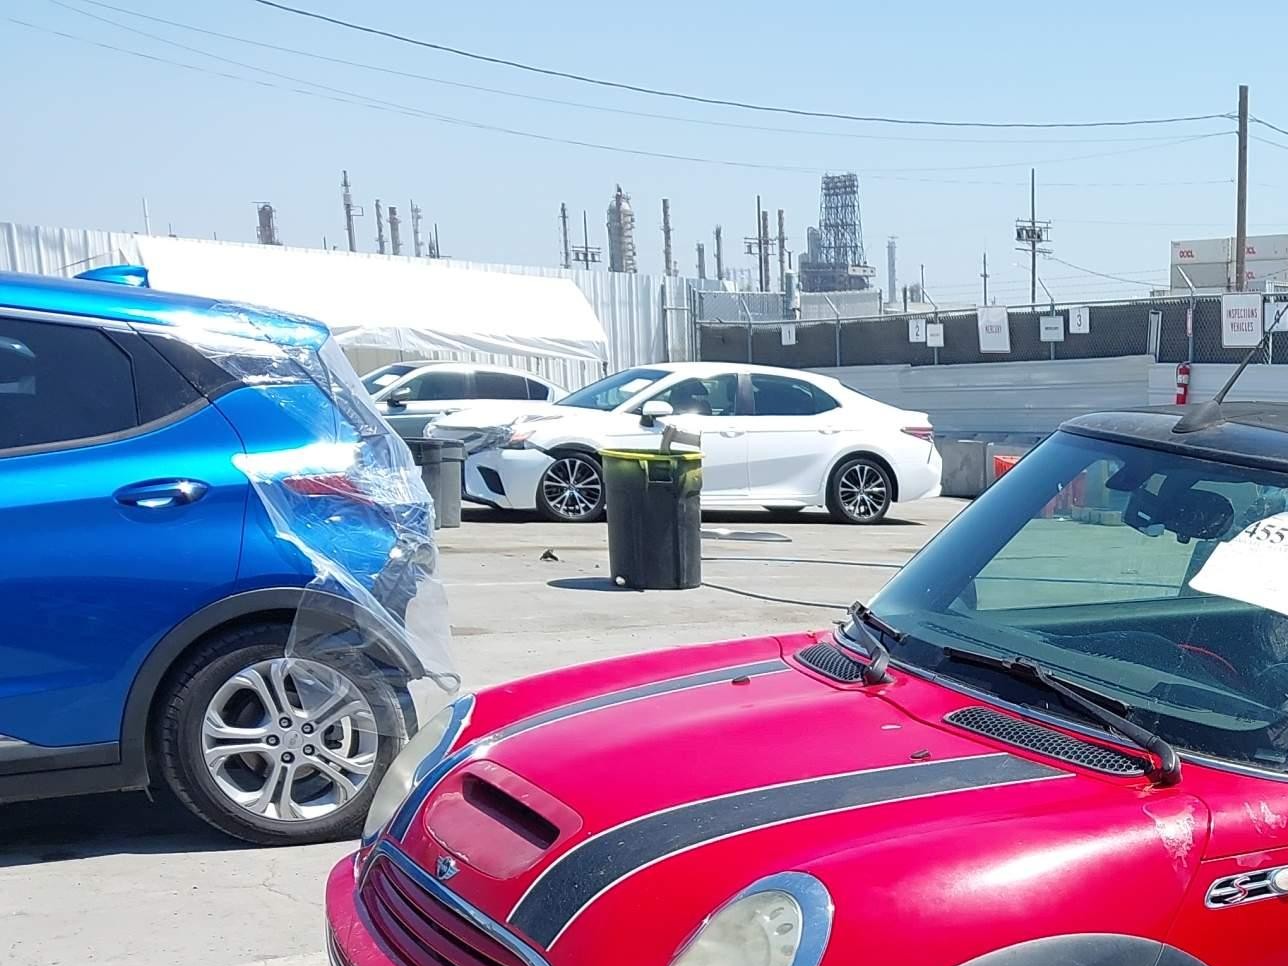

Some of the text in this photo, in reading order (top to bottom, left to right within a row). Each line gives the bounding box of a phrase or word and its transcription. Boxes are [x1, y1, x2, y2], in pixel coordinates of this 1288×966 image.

[1227, 308, 1257, 319] INSPECTIONS
[1076, 314, 1082, 327] 3
[1230, 322, 1254, 332] VEHICLES
